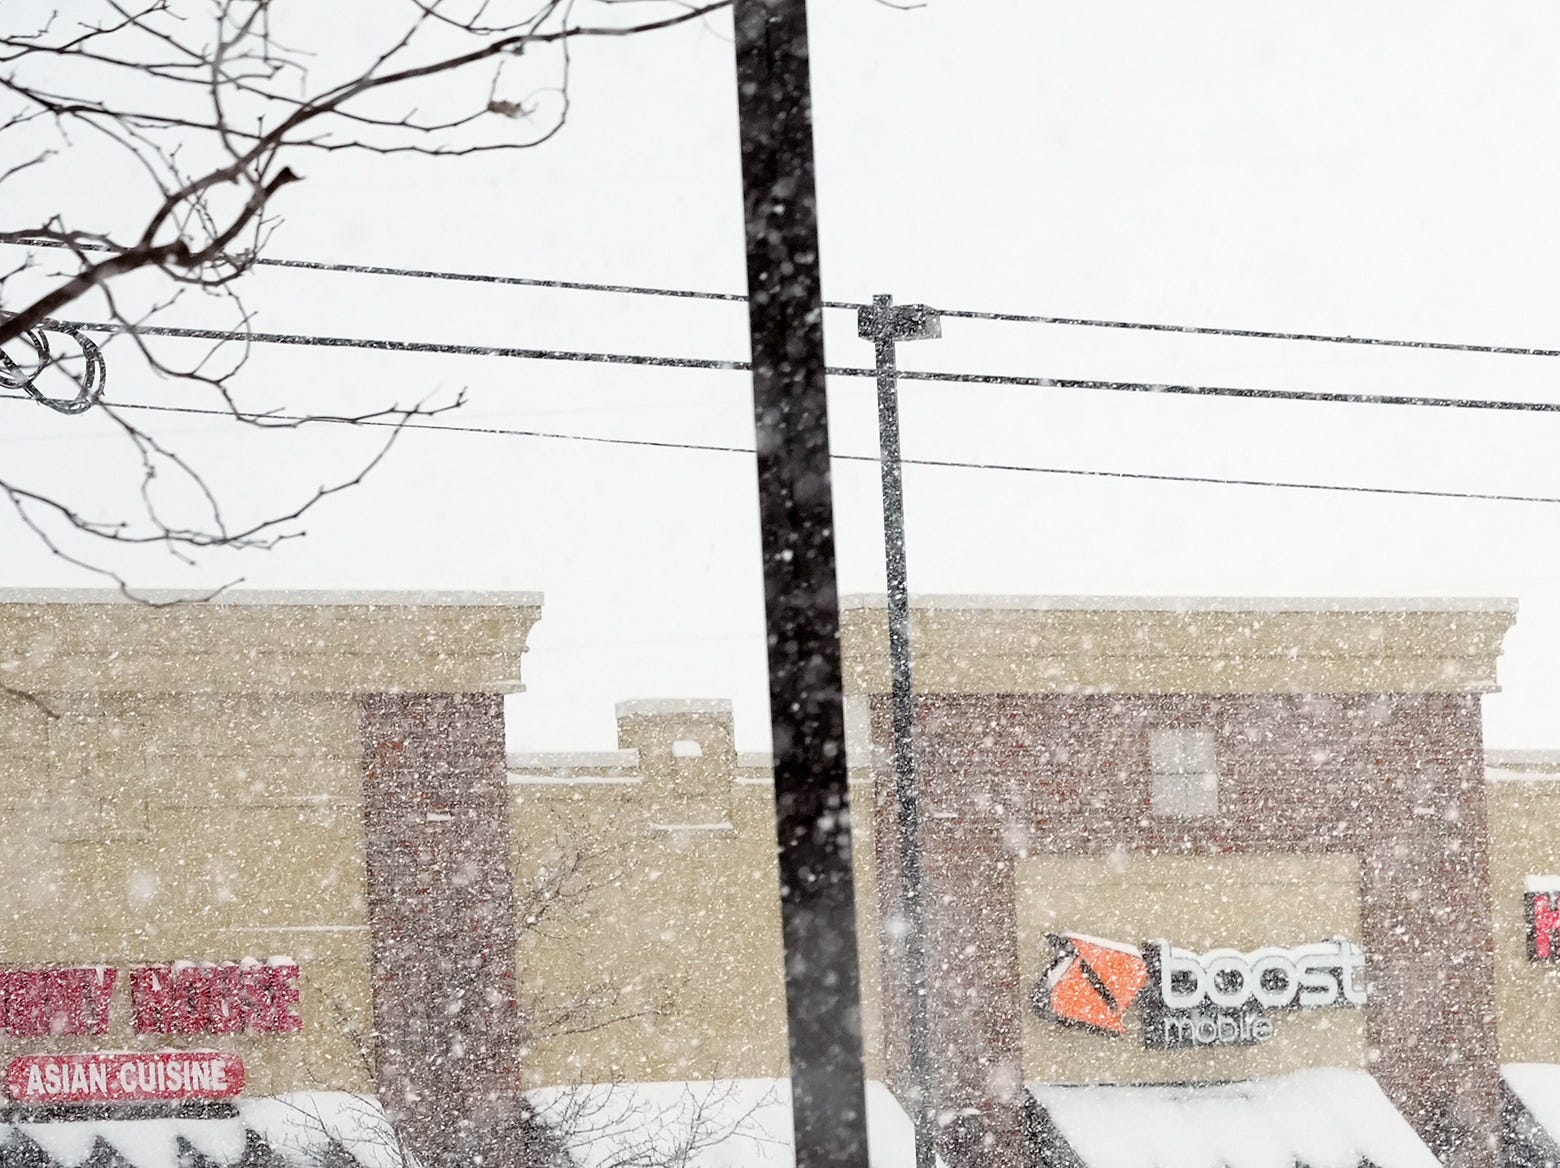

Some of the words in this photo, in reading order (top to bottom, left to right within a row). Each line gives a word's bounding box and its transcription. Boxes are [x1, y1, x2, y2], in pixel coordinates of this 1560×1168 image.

[1157, 939, 1368, 1010] boost
[1164, 1015, 1273, 1045] mobile
[26, 1062, 108, 1095] ASIAN
[119, 1059, 229, 1092] CUISINE
